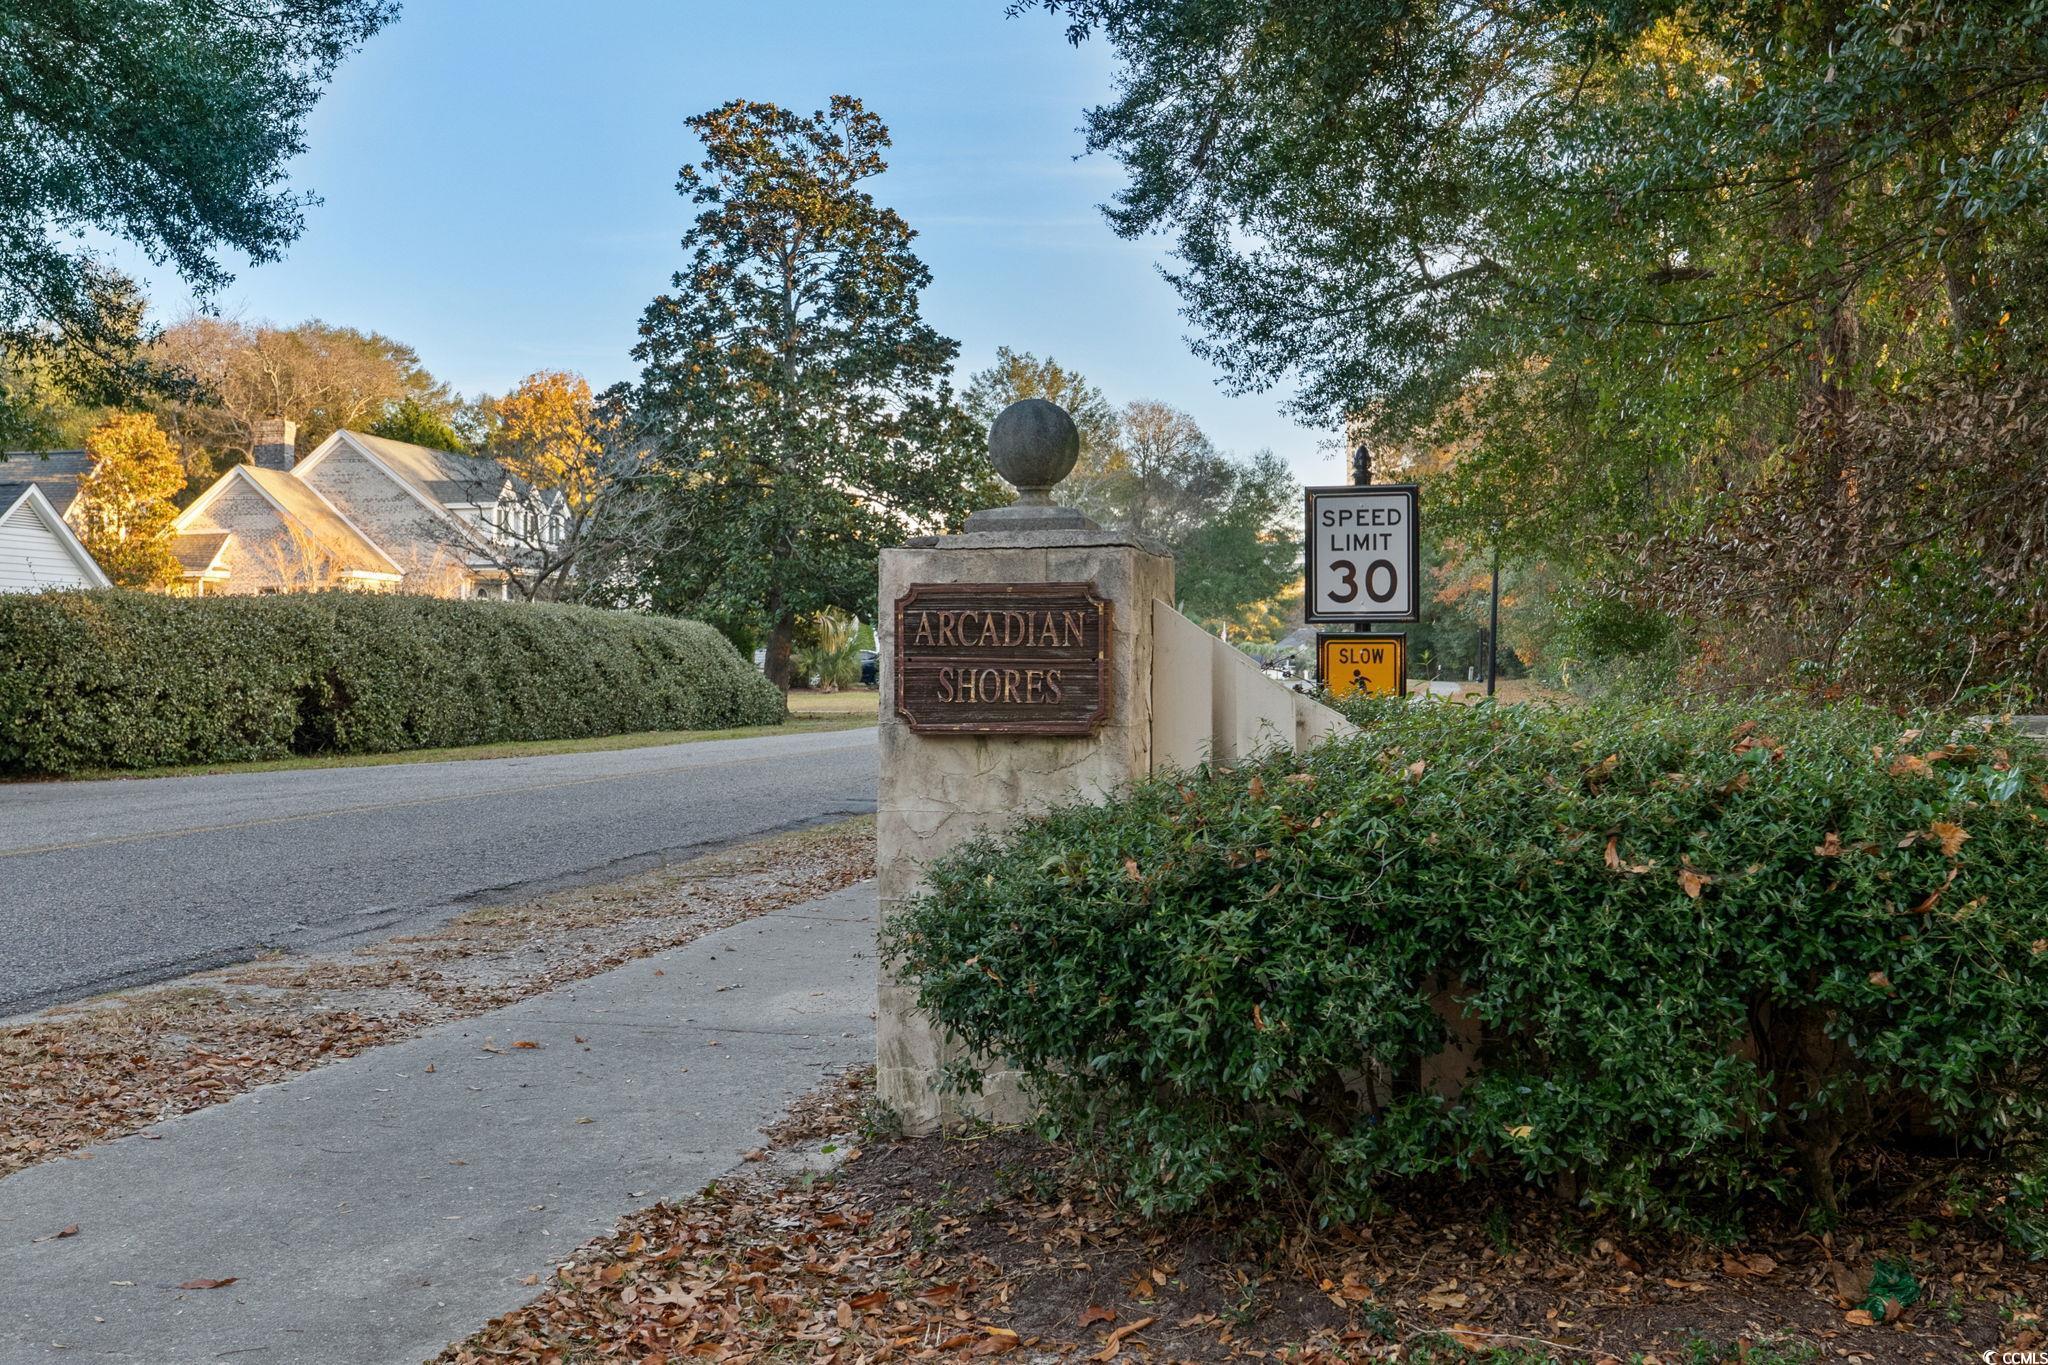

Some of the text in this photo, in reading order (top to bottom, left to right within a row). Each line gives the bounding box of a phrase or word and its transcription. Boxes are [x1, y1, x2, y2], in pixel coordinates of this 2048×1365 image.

[1322, 508, 1401, 527] SPEED
[1331, 533, 1392, 551] LIMIT
[1327, 559, 1398, 603] 30
[913, 610, 1086, 647] ARCADIAN
[1339, 648, 1384, 664] SLOW
[937, 666, 1062, 704] SHORES
